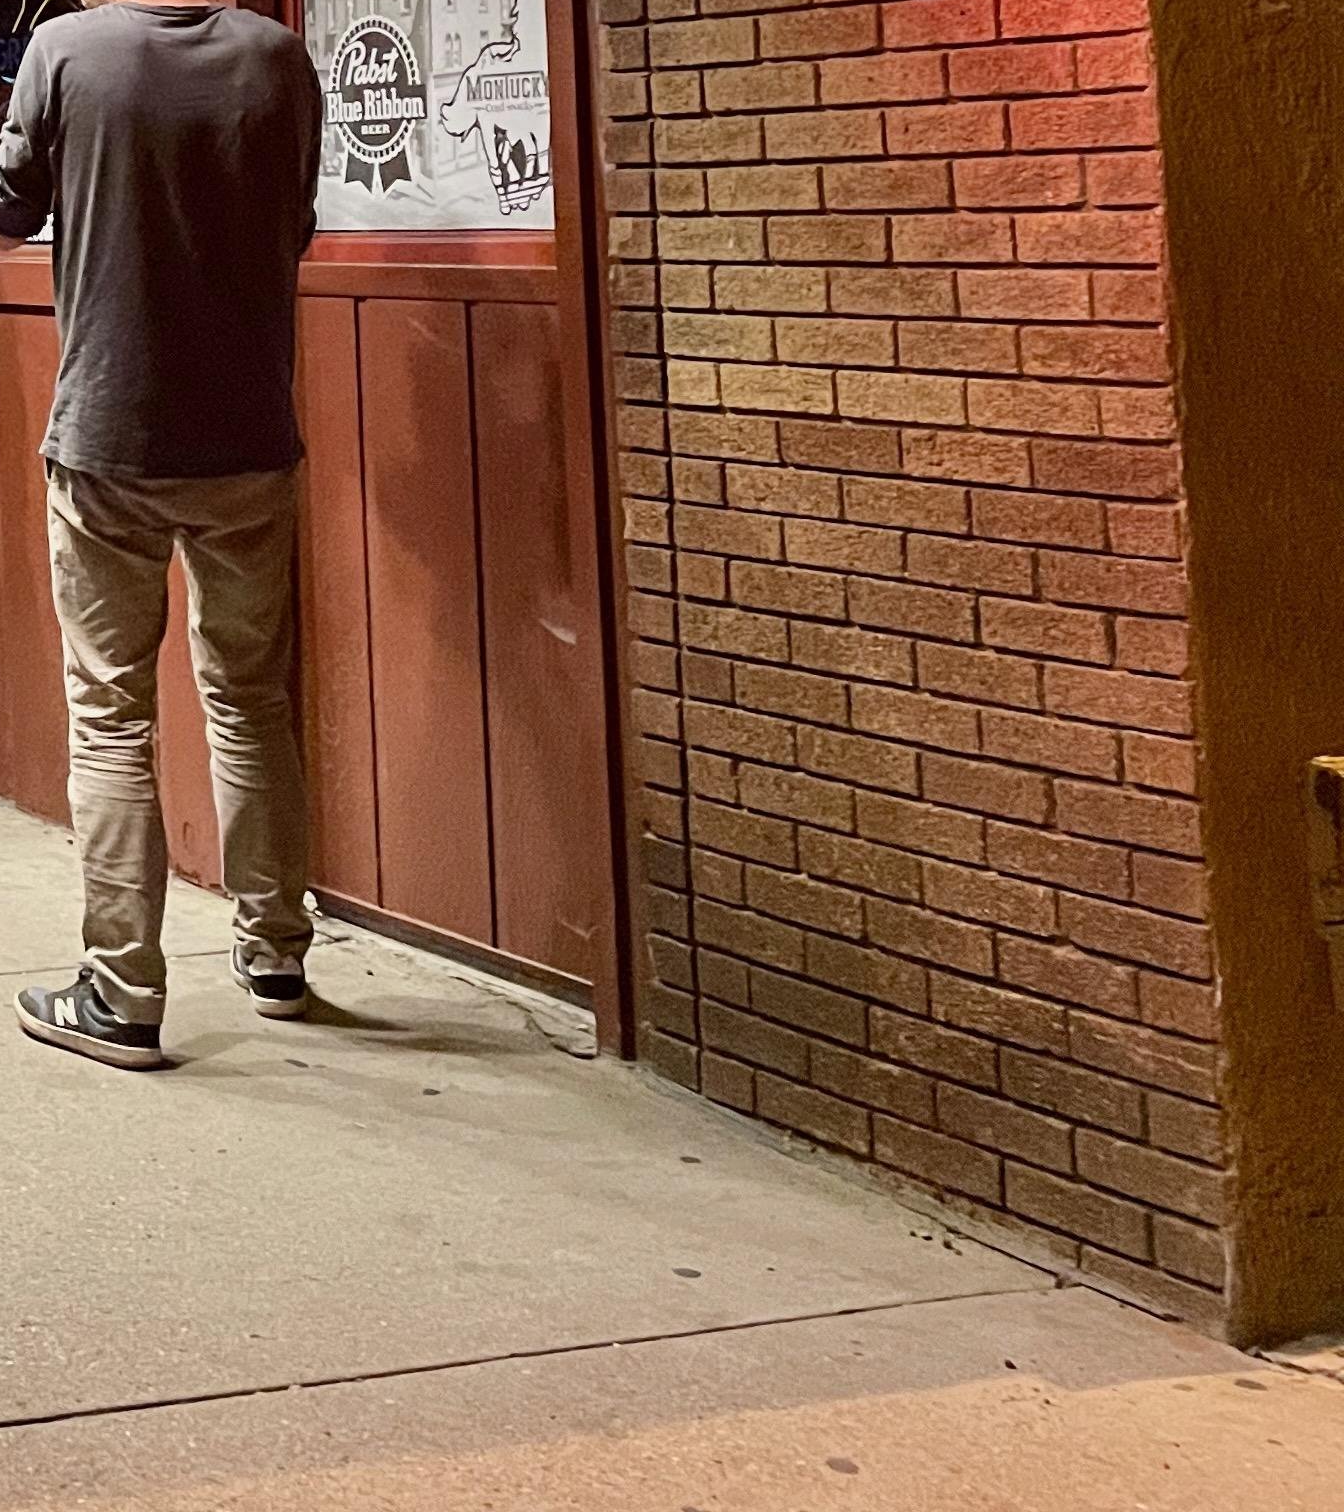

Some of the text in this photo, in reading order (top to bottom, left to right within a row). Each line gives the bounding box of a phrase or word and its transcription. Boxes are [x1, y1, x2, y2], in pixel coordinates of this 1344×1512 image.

[345, 40, 401, 86] Pabst
[325, 87, 426, 124] Blue Ribbon
[361, 124, 391, 135] BEER
[54, 996, 80, 1026] N
